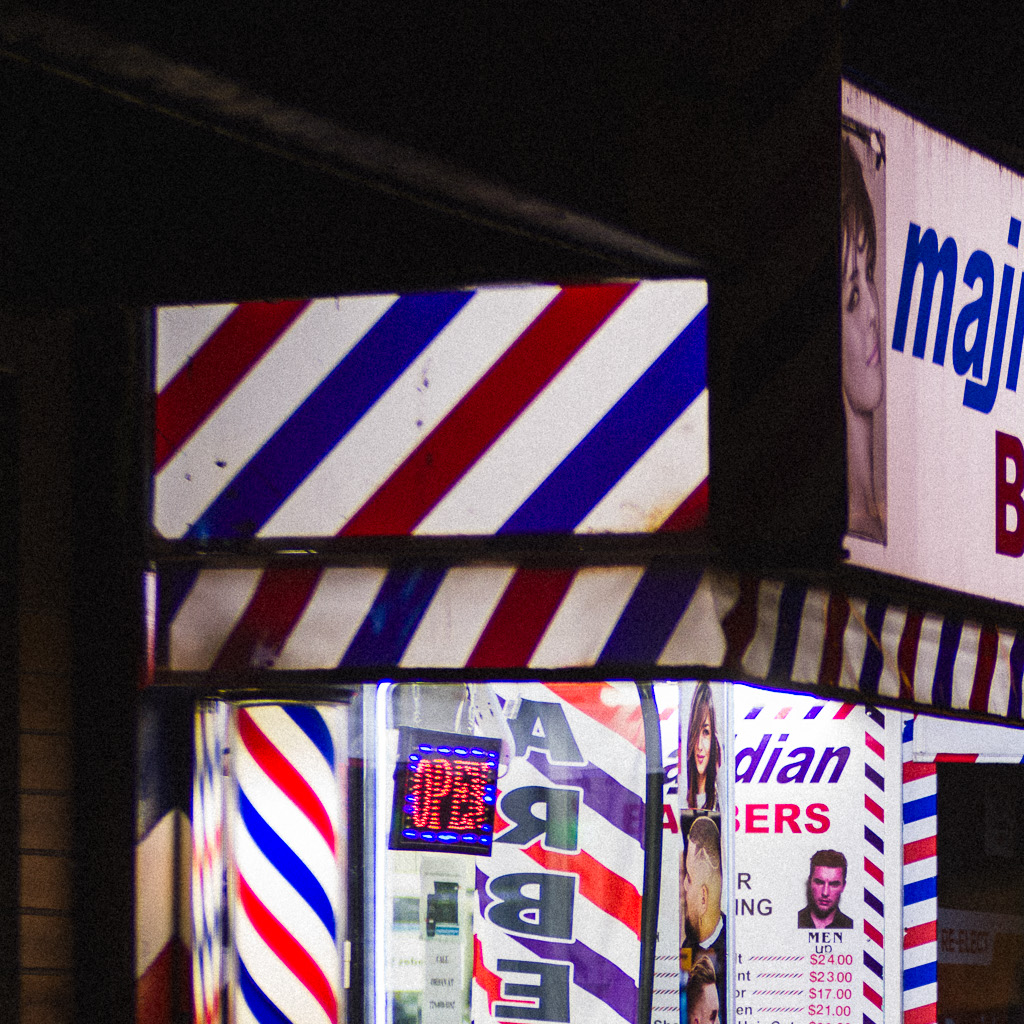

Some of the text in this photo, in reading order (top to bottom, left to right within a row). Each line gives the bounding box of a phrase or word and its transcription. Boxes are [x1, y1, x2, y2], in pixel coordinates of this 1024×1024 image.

[808, 932, 843, 944] MEN
[810, 954, 853, 966] $24.00
[809, 971, 853, 983] $23.00
[809, 988, 852, 1000] $17.00
[808, 1005, 851, 1017] $21.00
